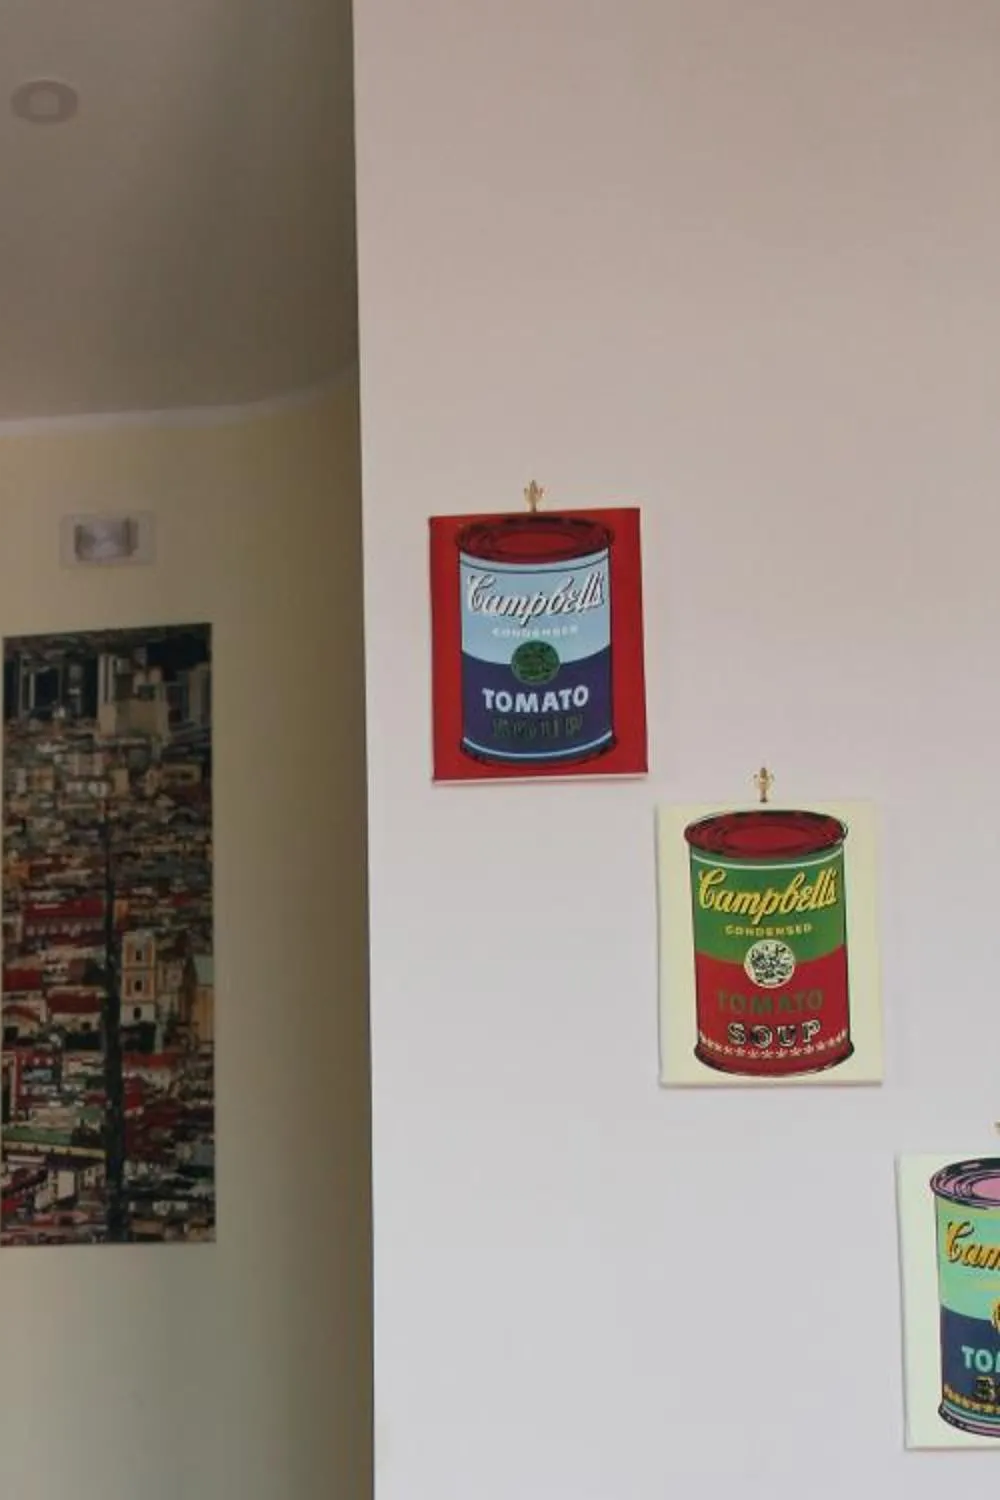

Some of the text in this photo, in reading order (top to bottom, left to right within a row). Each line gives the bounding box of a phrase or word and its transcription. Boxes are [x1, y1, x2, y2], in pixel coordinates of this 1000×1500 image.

[482, 684, 589, 713] TOMATO
[725, 923, 812, 937] CONDENSED
[717, 988, 823, 1014] TOMATO
[727, 1019, 820, 1048] SOUP
